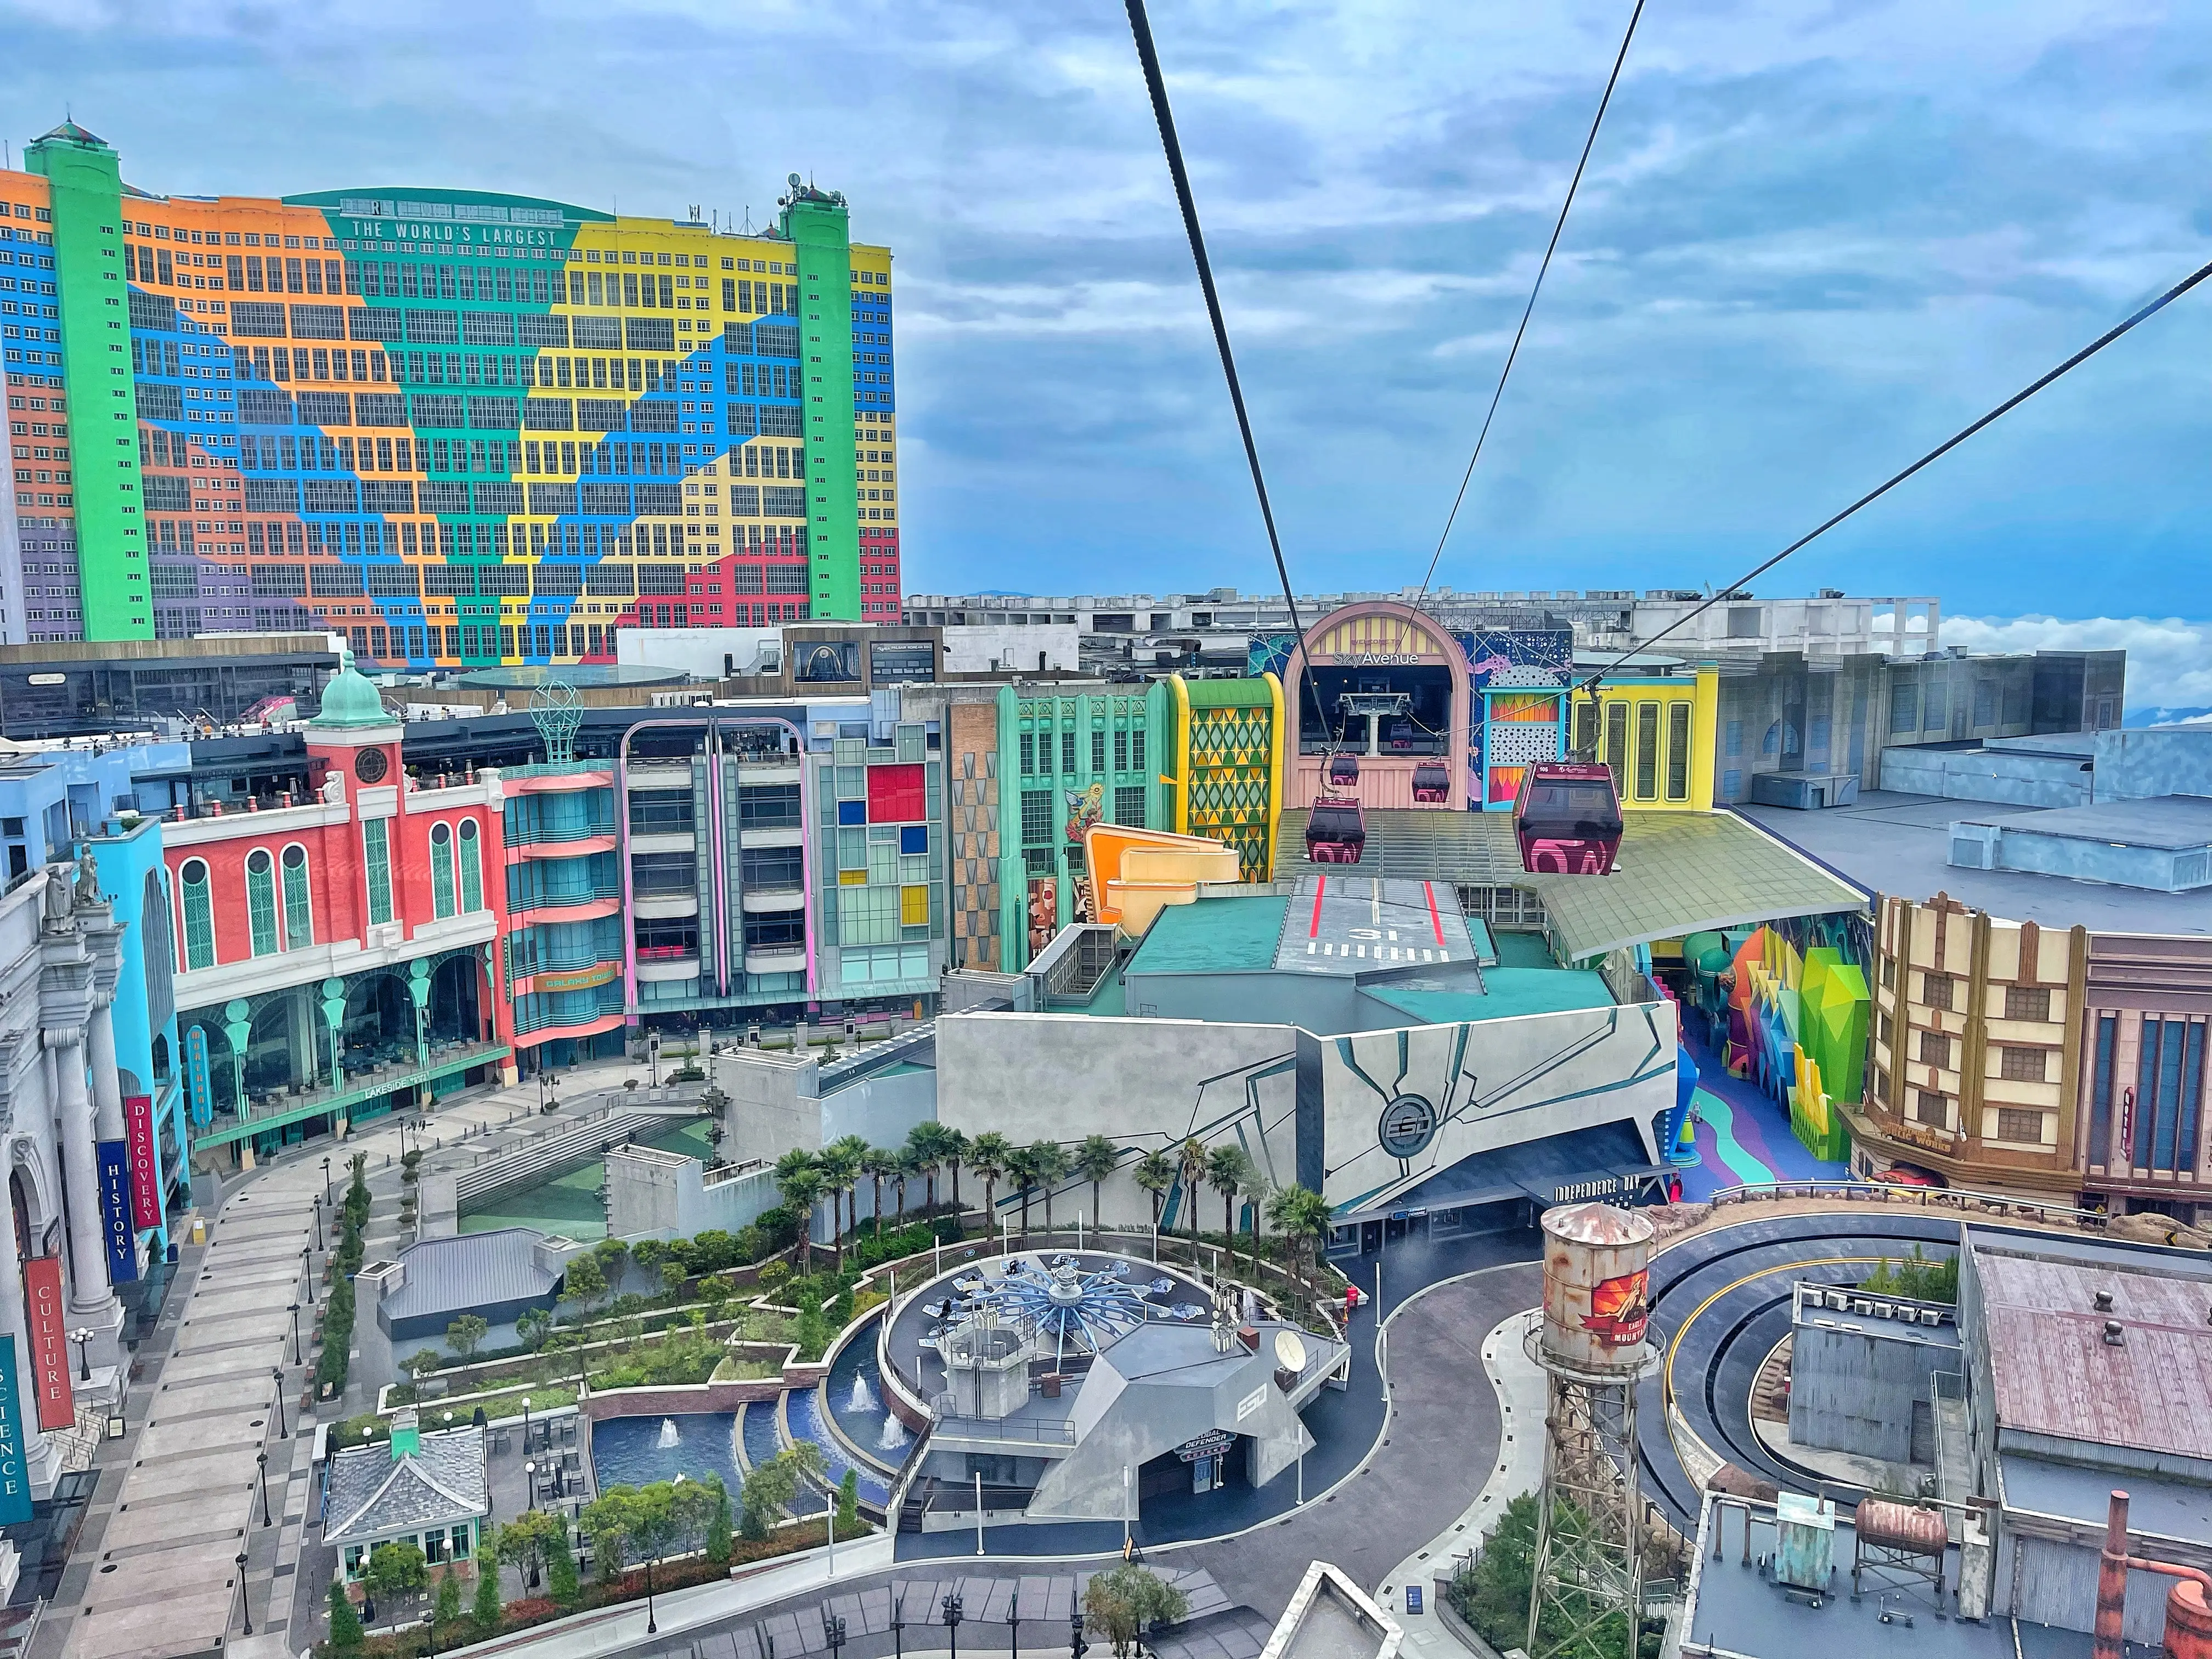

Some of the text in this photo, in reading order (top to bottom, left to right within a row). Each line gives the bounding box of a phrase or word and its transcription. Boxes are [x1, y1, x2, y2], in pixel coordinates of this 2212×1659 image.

[352, 221, 556, 246] THE WORLD'S LARGEST
[364, 1079, 408, 1099] LAKESIDE
[1385, 1116, 1432, 1138] ESD
[134, 1105, 153, 1220] DISCOVERY
[1554, 1174, 1640, 1202] INDEPENDENCE DAY
[108, 1165, 127, 1260] HISTORY
[38, 1285, 61, 1400] CULTURE
[1186, 1434, 1227, 1448] DEFENDER
